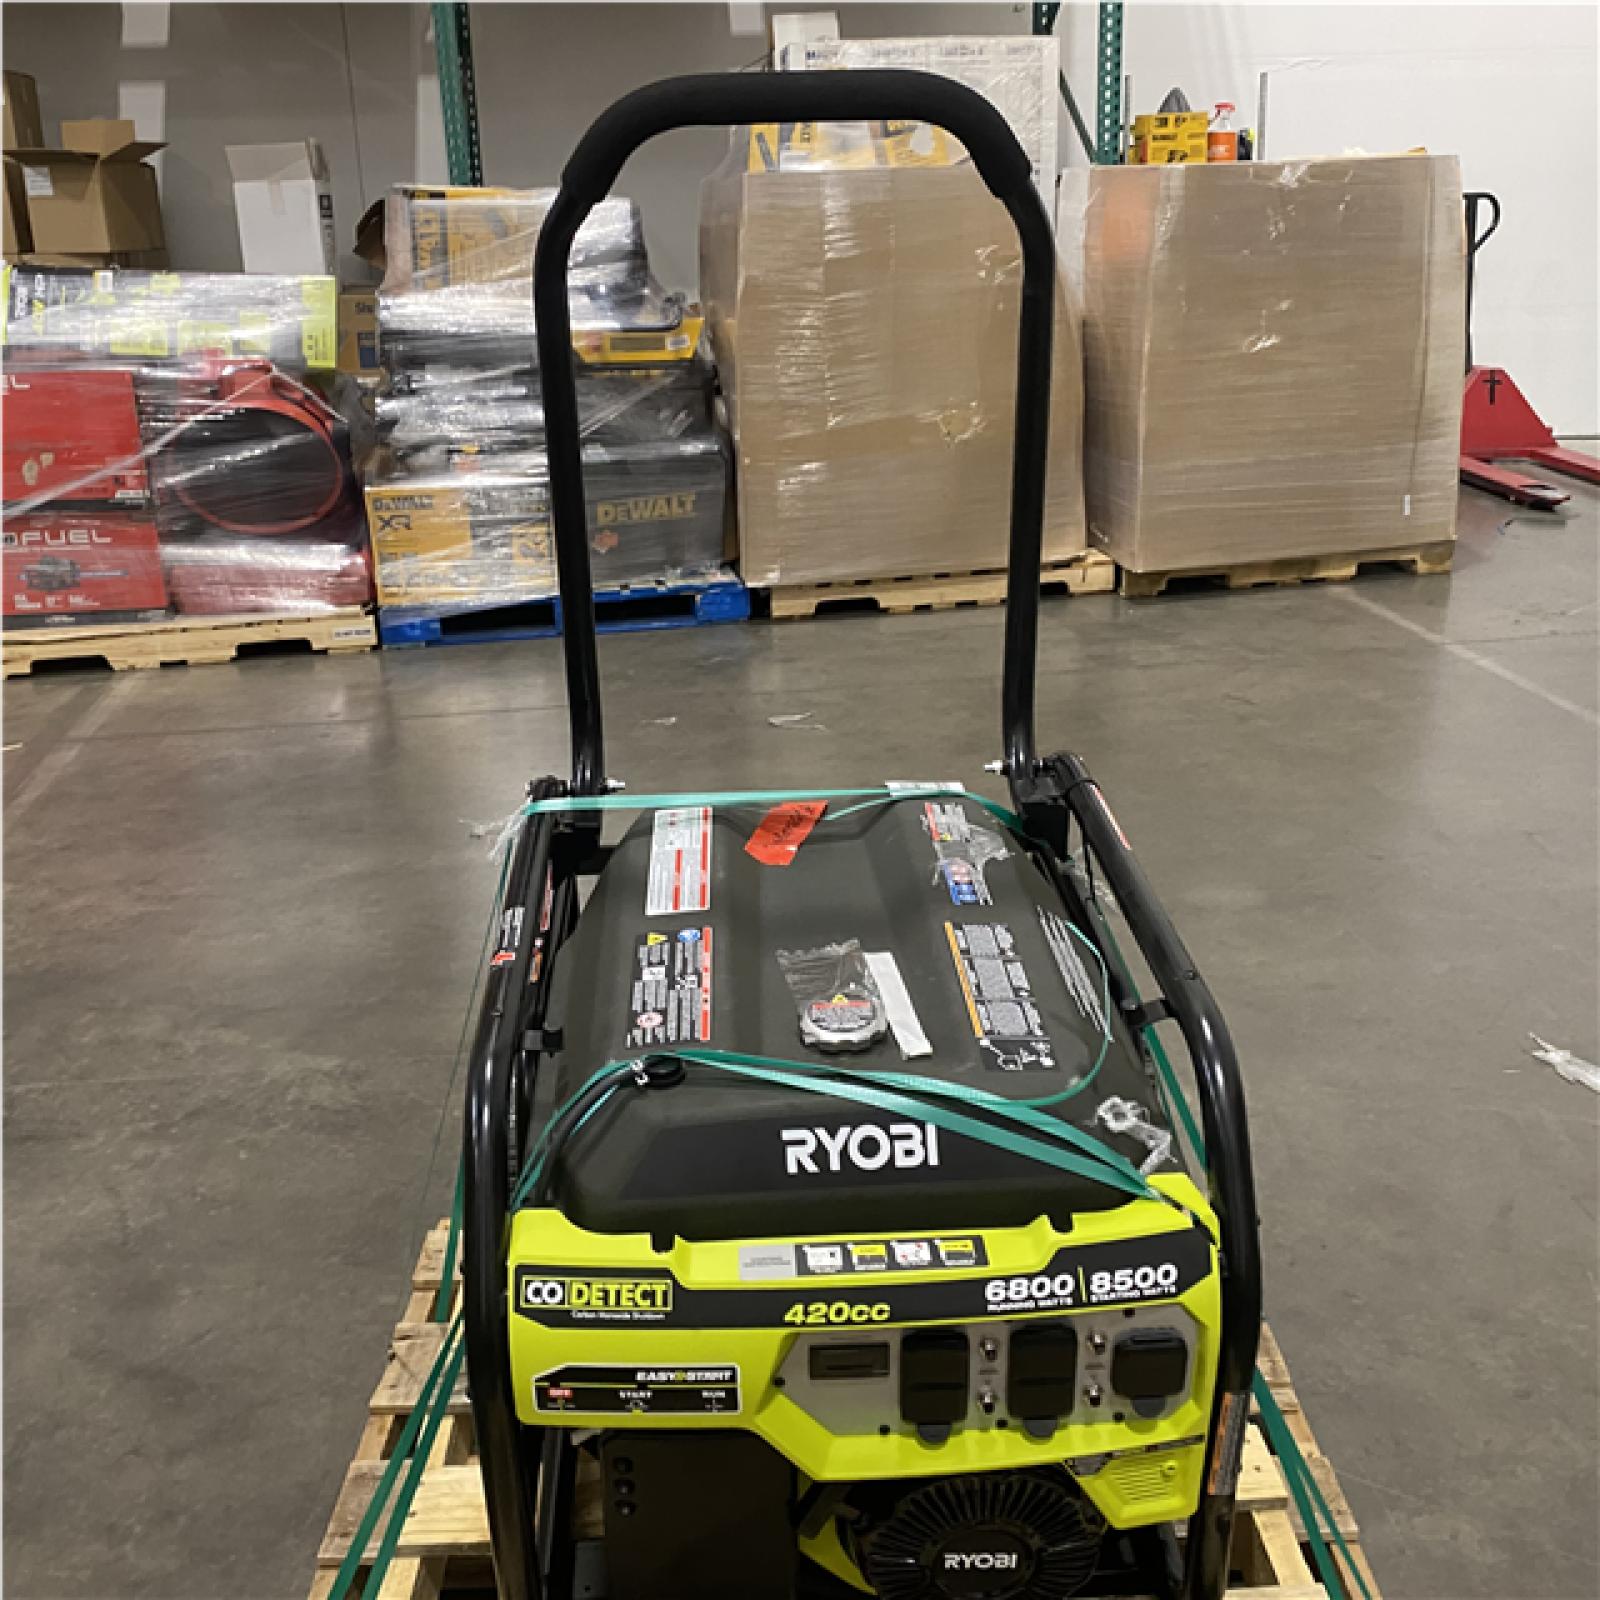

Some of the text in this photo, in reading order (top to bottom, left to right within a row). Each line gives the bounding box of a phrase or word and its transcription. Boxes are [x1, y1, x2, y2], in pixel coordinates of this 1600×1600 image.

[22, 529, 113, 546] FUEL
[781, 1122, 940, 1175] RYOBI
[526, 1281, 668, 1307] CO DETECT
[985, 1262, 1178, 1301] 6800 8500
[784, 1301, 891, 1325] 420cc
[944, 1553, 1019, 1570] RYOBI
